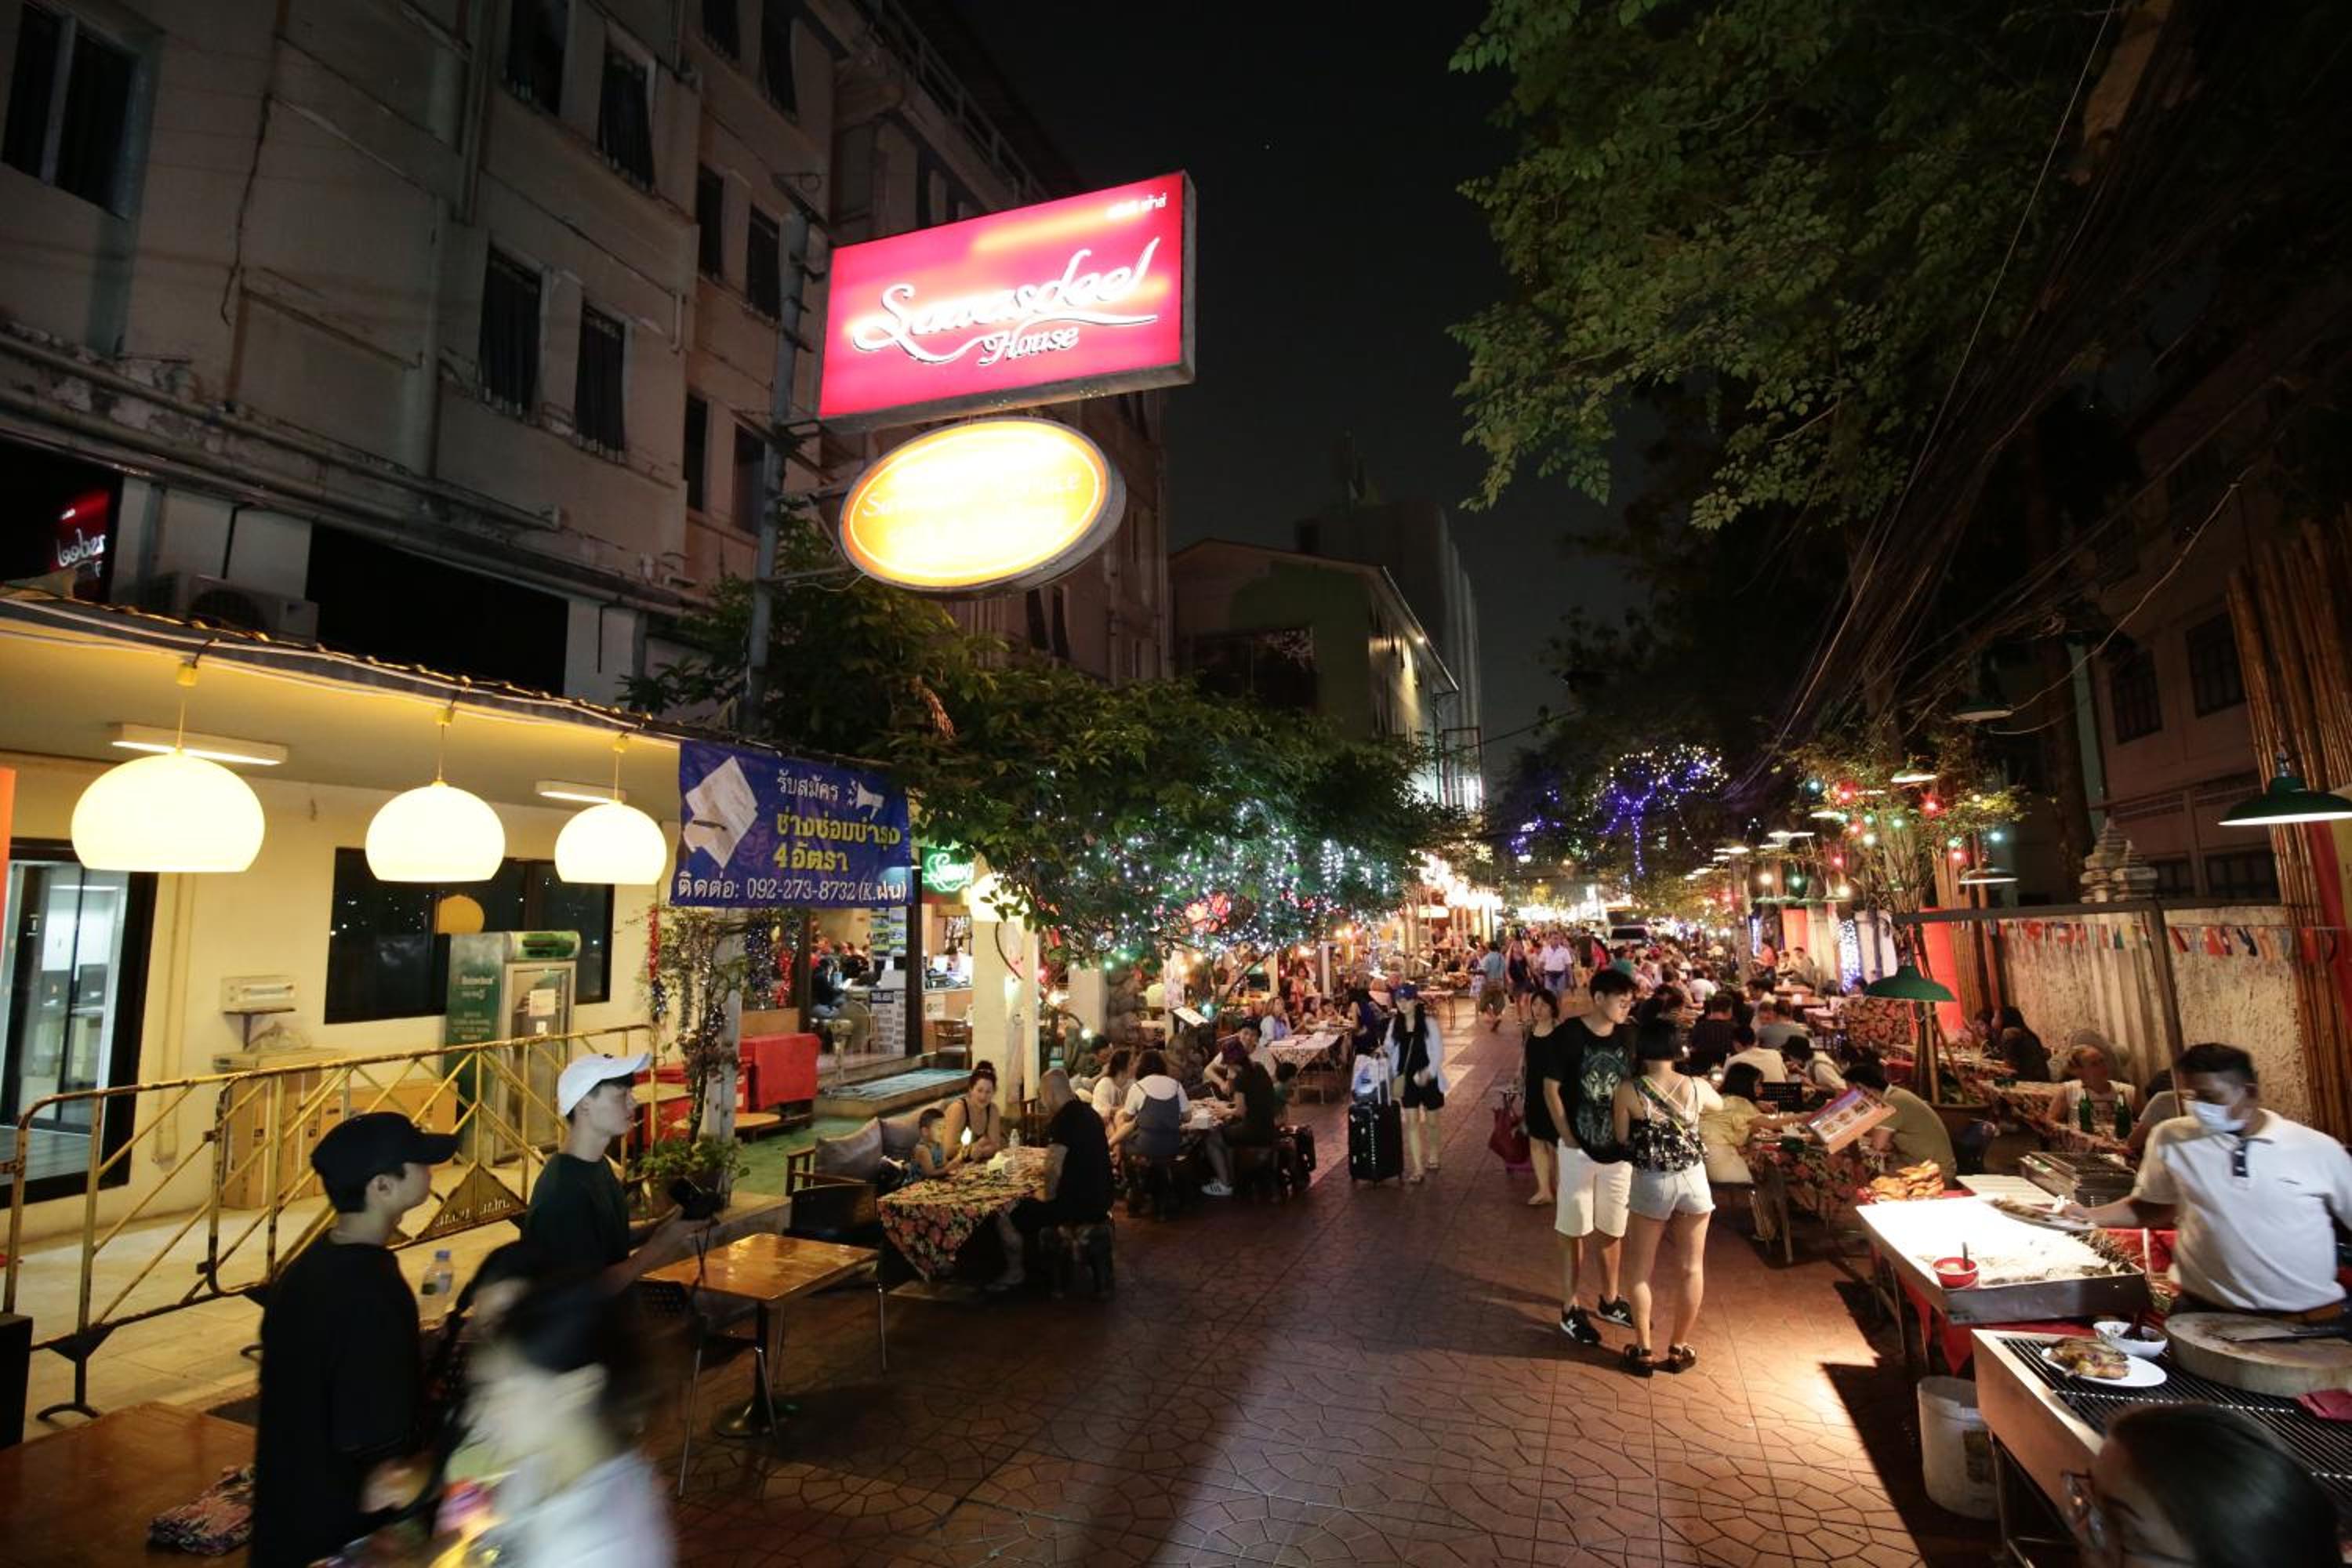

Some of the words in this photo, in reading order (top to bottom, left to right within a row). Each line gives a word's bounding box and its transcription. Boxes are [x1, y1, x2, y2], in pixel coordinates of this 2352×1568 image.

[978, 327, 1079, 365] House
[777, 768, 839, 801] รับสมัคร
[777, 805, 901, 851] ช่างซ่อมบำรุง
[773, 841, 787, 869] 4
[790, 841, 849, 872] อัตรา
[747, 877, 855, 901] 092-273-8732
